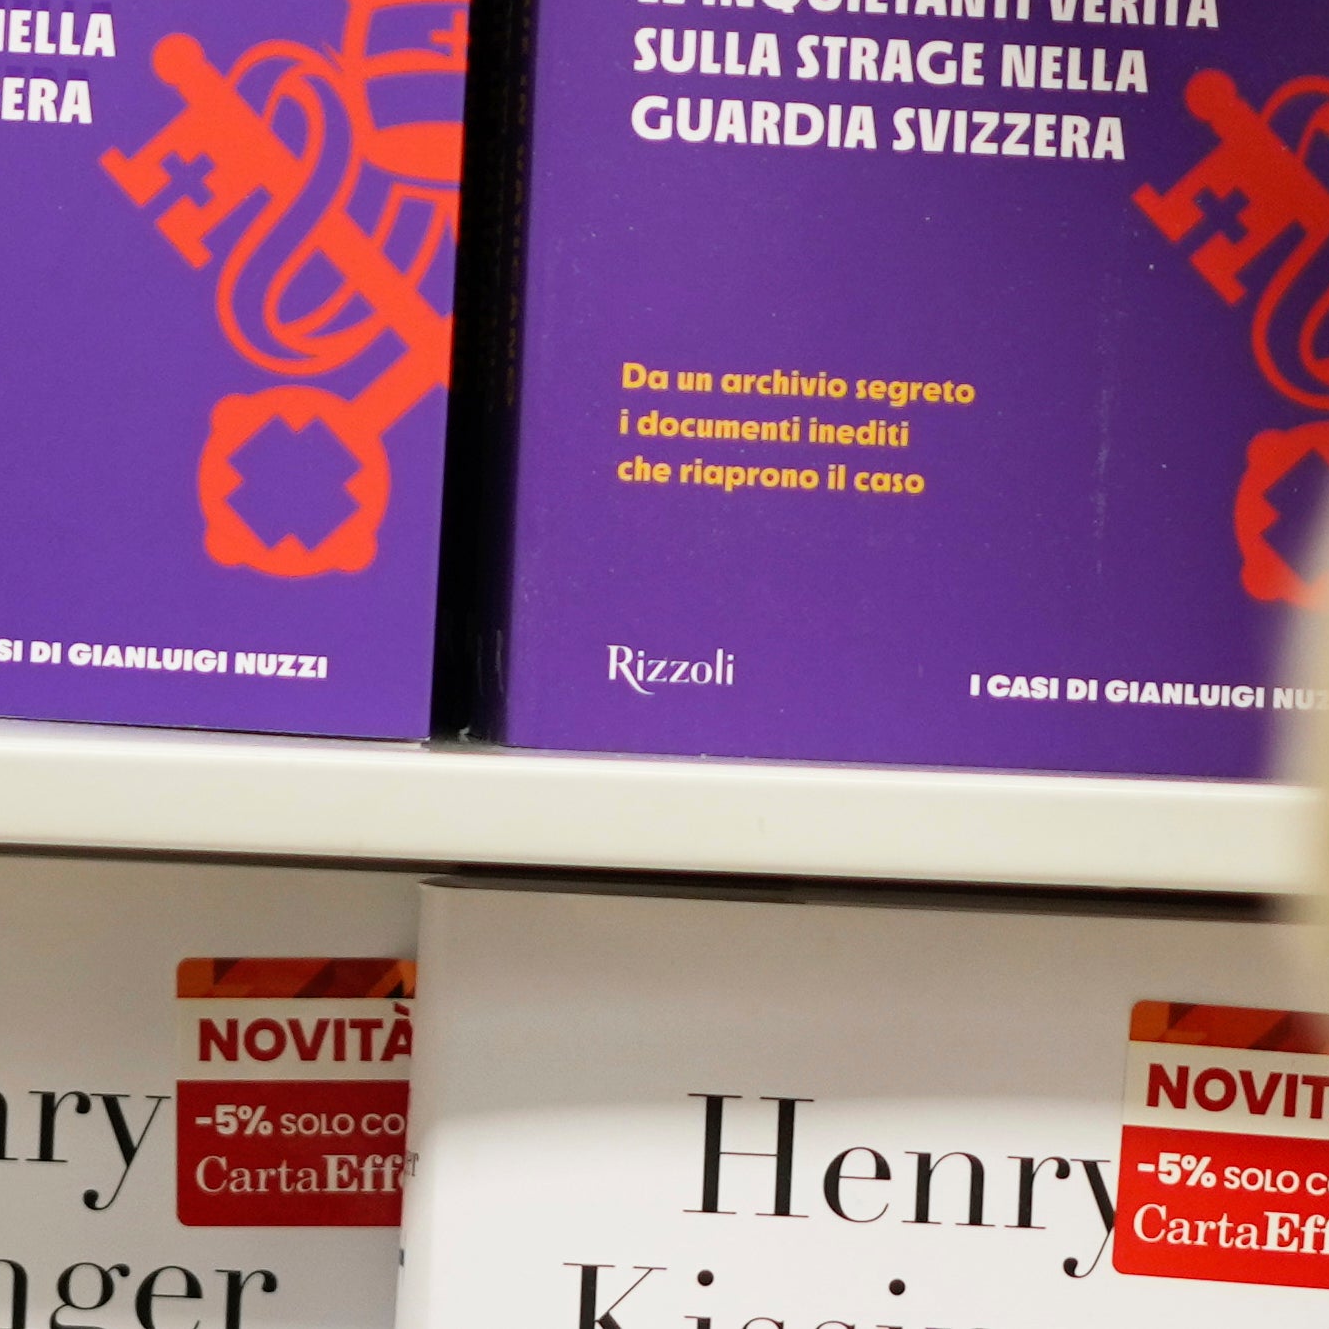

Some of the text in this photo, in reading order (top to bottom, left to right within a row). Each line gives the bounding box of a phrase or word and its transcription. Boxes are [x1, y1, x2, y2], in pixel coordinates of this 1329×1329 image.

[633, 26, 1148, 94] SULLA STRAGE NELLA
[630, 95, 1126, 161] GUARDIA SVIZZERA
[621, 361, 976, 408] Da un archivio segreto
[618, 408, 910, 447] i documenti inediti
[617, 455, 926, 495] che riaprono il caso
[30, 639, 62, 665] DI
[67, 641, 228, 675] GIANLUIGI
[234, 651, 329, 680] NUZZI
[606, 643, 735, 696] Rizzoli
[969, 673, 980, 697] I
[986, 675, 1060, 702] CASI
[1065, 678, 1099, 704] DI
[1104, 679, 1265, 711] GIANLUIGI
[196, 1002, 414, 1063] NOVITÀ
[194, 1104, 406, 1138] -5% SOLO CO
[194, 1152, 404, 1196] CartaEff
[682, 1091, 1115, 1281] Henry
[1136, 1150, 1218, 1188] -5%
[1223, 1163, 1302, 1195] SOLO
